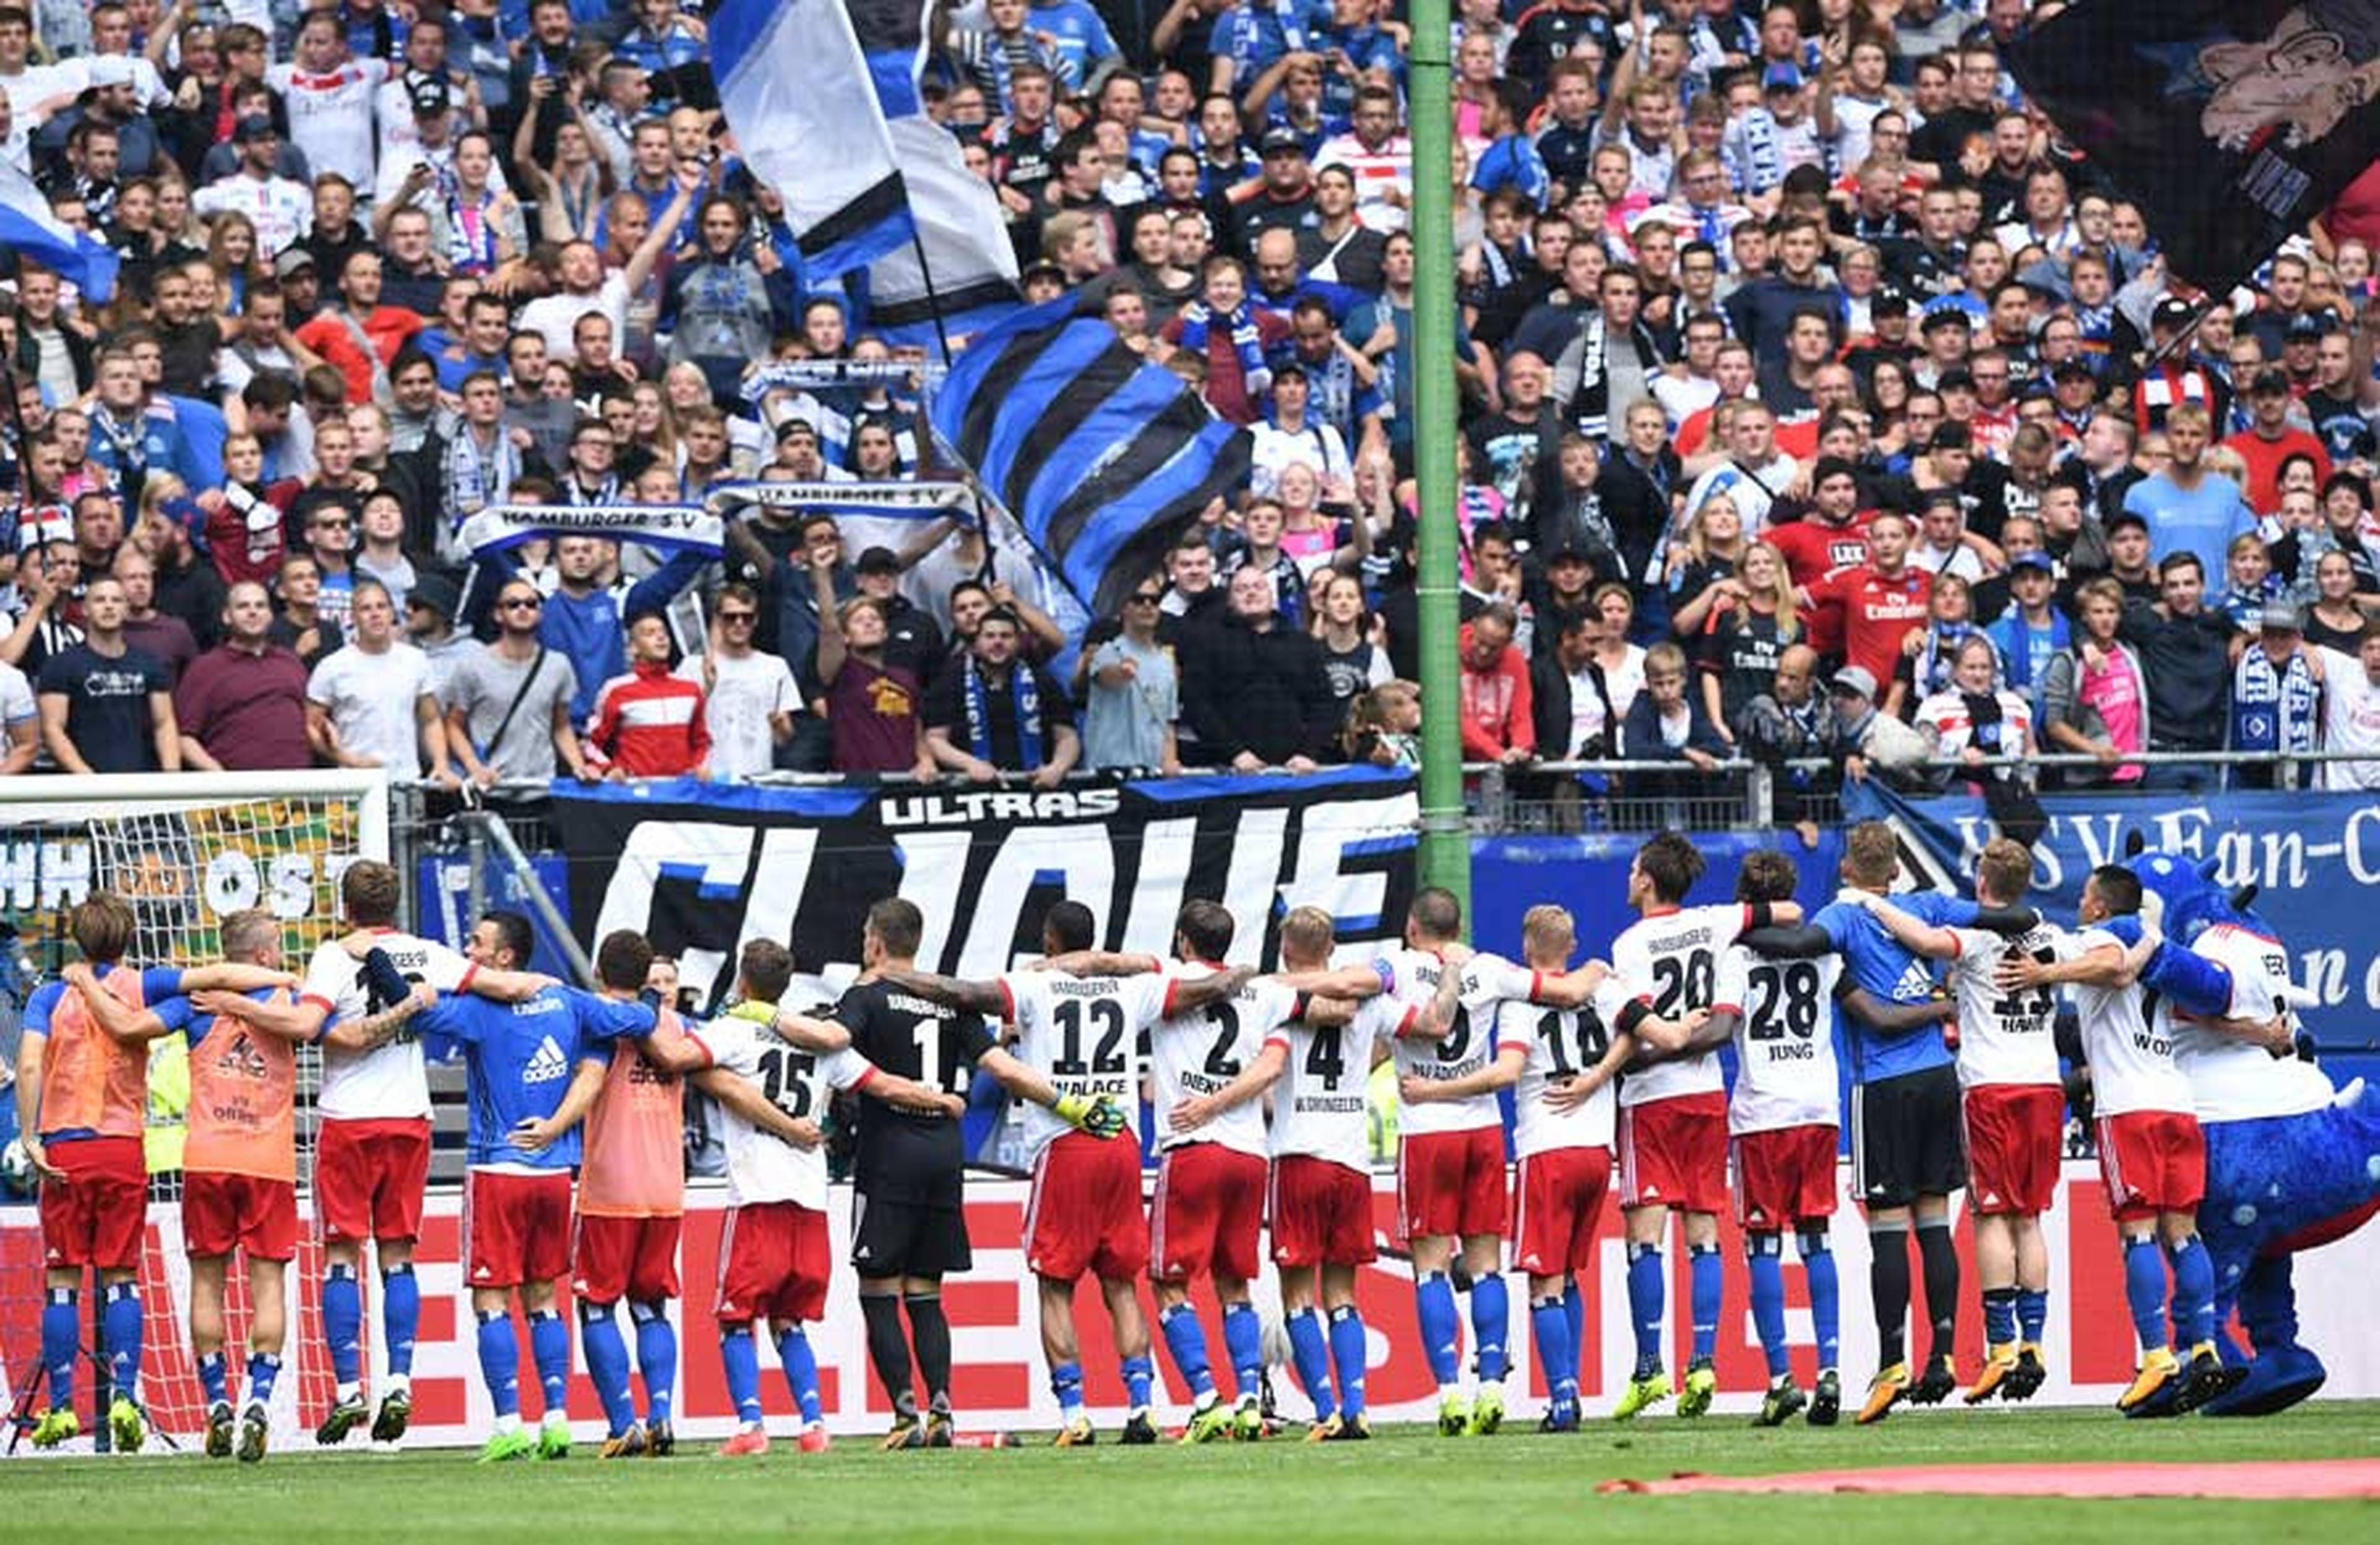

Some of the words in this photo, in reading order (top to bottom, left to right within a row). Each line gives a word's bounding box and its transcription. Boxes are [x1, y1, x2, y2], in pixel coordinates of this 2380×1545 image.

[503, 511, 649, 527] HAMBURGER
[881, 788, 1120, 825] ULTRAS
[591, 793, 1419, 1016] CLIQUE
[1653, 949, 1714, 1020] 20
[1748, 962, 1819, 1040] 28
[522, 1060, 568, 1083] adidas
[913, 1018, 944, 1094] 1
[1053, 999, 1126, 1076] 12
[1204, 1003, 1241, 1076] 2
[1305, 1026, 1344, 1091] 4
[1769, 1042, 1814, 1060] JUNG
[757, 1049, 816, 1119] 15
[1052, 1080, 1128, 1097] WALACE
